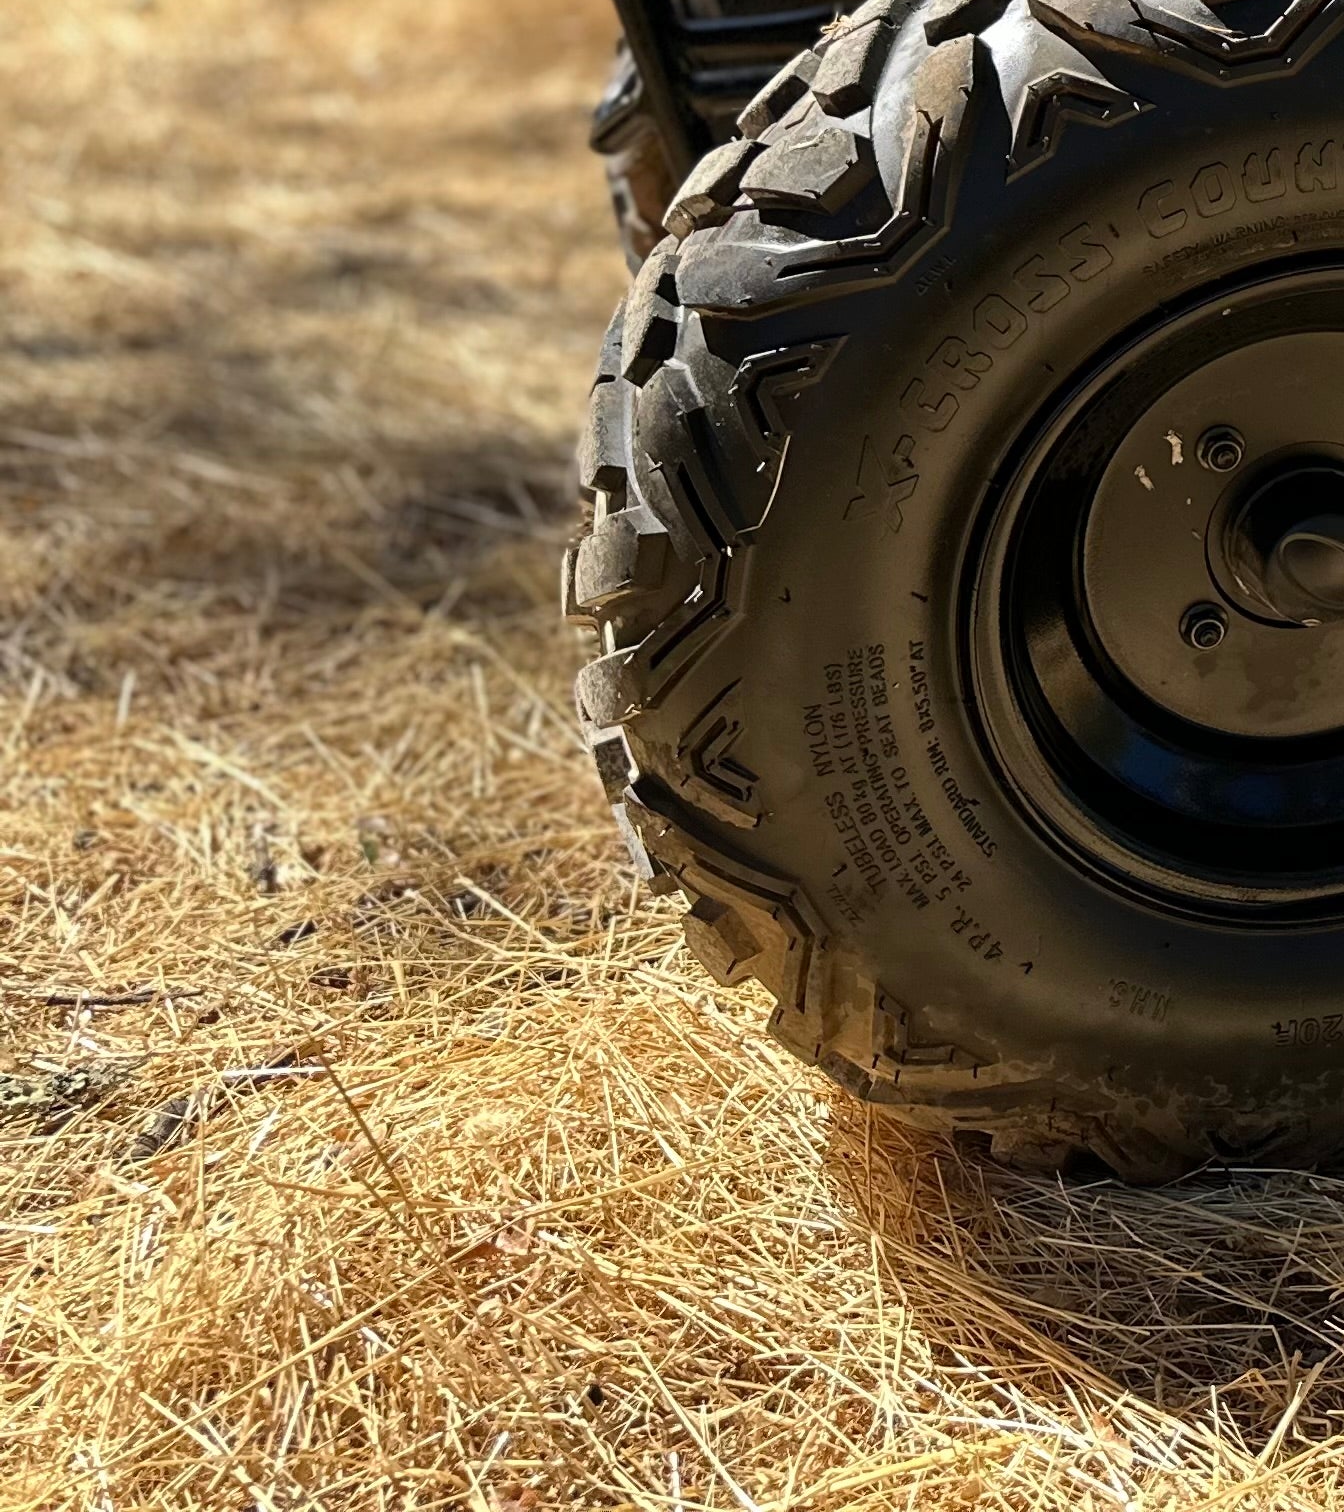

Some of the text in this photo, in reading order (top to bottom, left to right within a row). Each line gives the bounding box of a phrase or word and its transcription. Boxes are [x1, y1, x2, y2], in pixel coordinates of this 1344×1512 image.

[908, 639, 925, 662] AT
[847, 647, 873, 744] PRESSURE
[867, 643, 889, 707] BEADS
[874, 713, 899, 759] SEAT
[839, 755, 859, 775] AT
[890, 766, 910, 791] TO
[802, 703, 888, 896] TUBELESS NYLON
[861, 752, 913, 846] OPERATING
[941, 776, 999, 859] STANDARD
[868, 828, 902, 872] LOAD
[950, 869, 974, 893] 24
